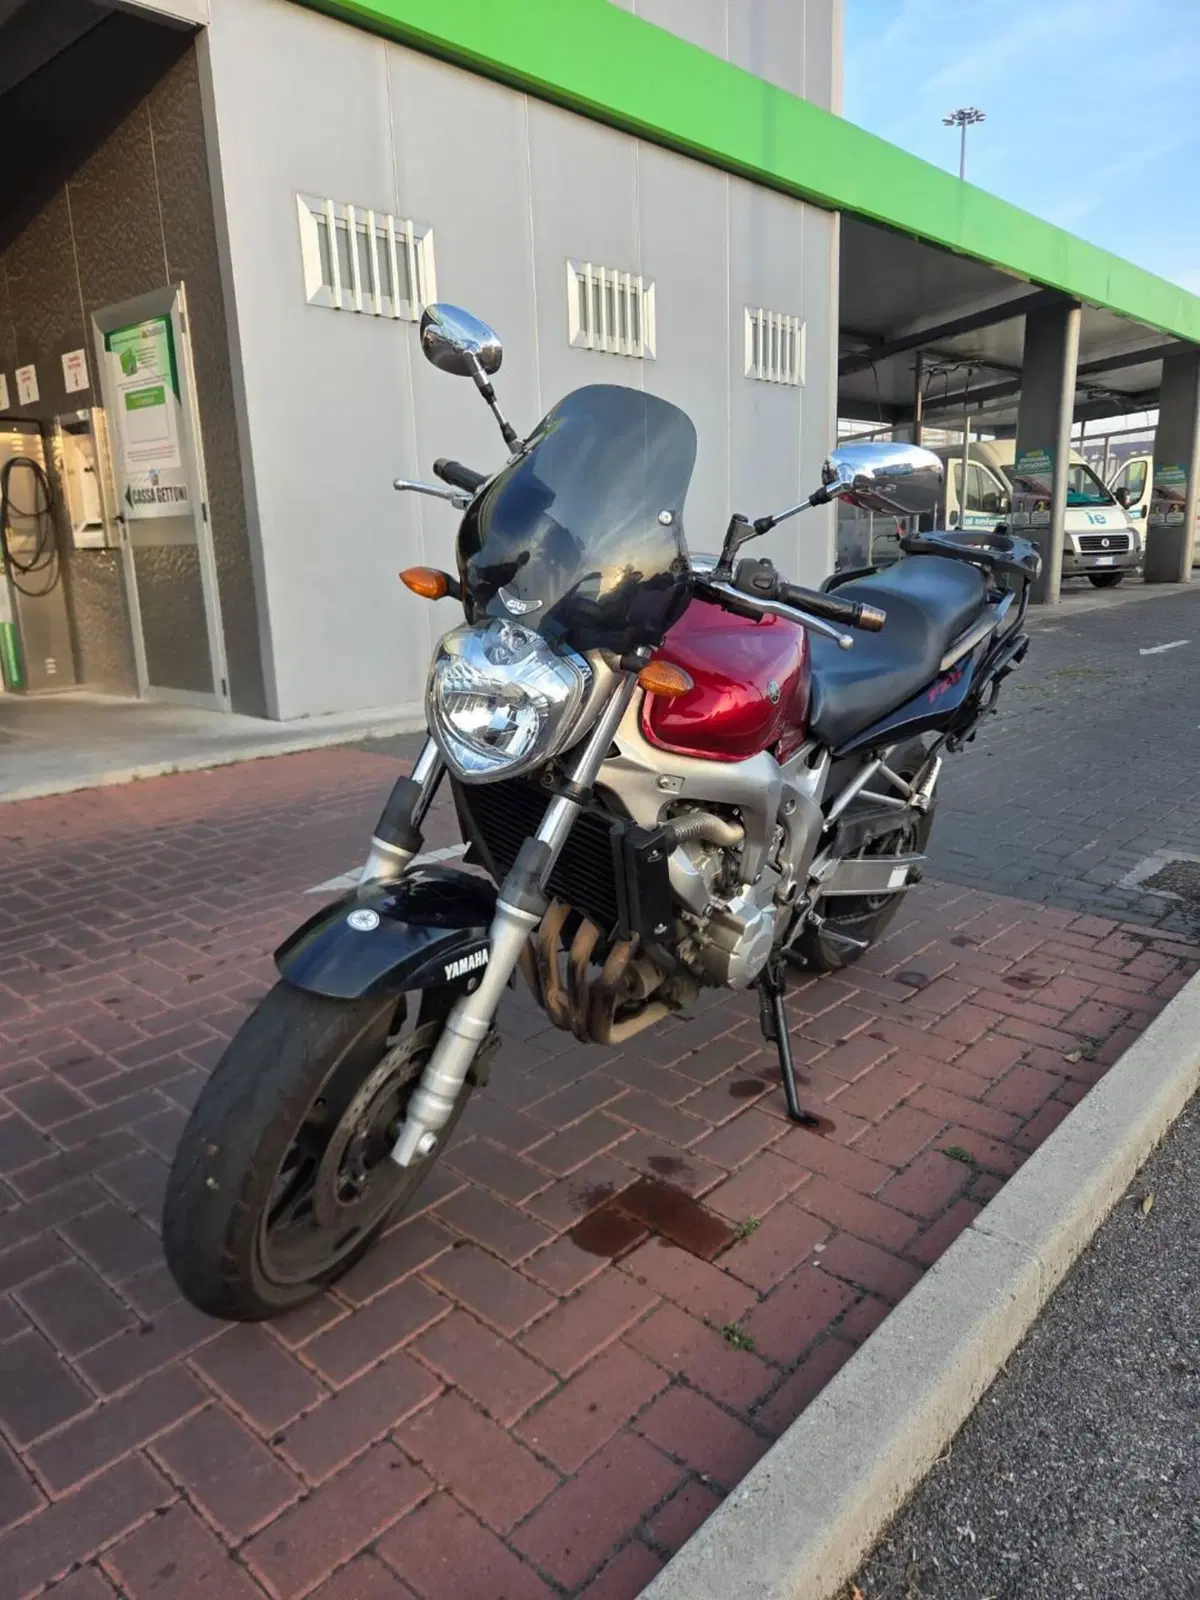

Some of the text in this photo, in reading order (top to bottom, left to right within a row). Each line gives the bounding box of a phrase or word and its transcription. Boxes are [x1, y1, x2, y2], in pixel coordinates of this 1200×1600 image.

[132, 486, 188, 504] CASSA GETTONI
[444, 948, 489, 981] YAMAHA
